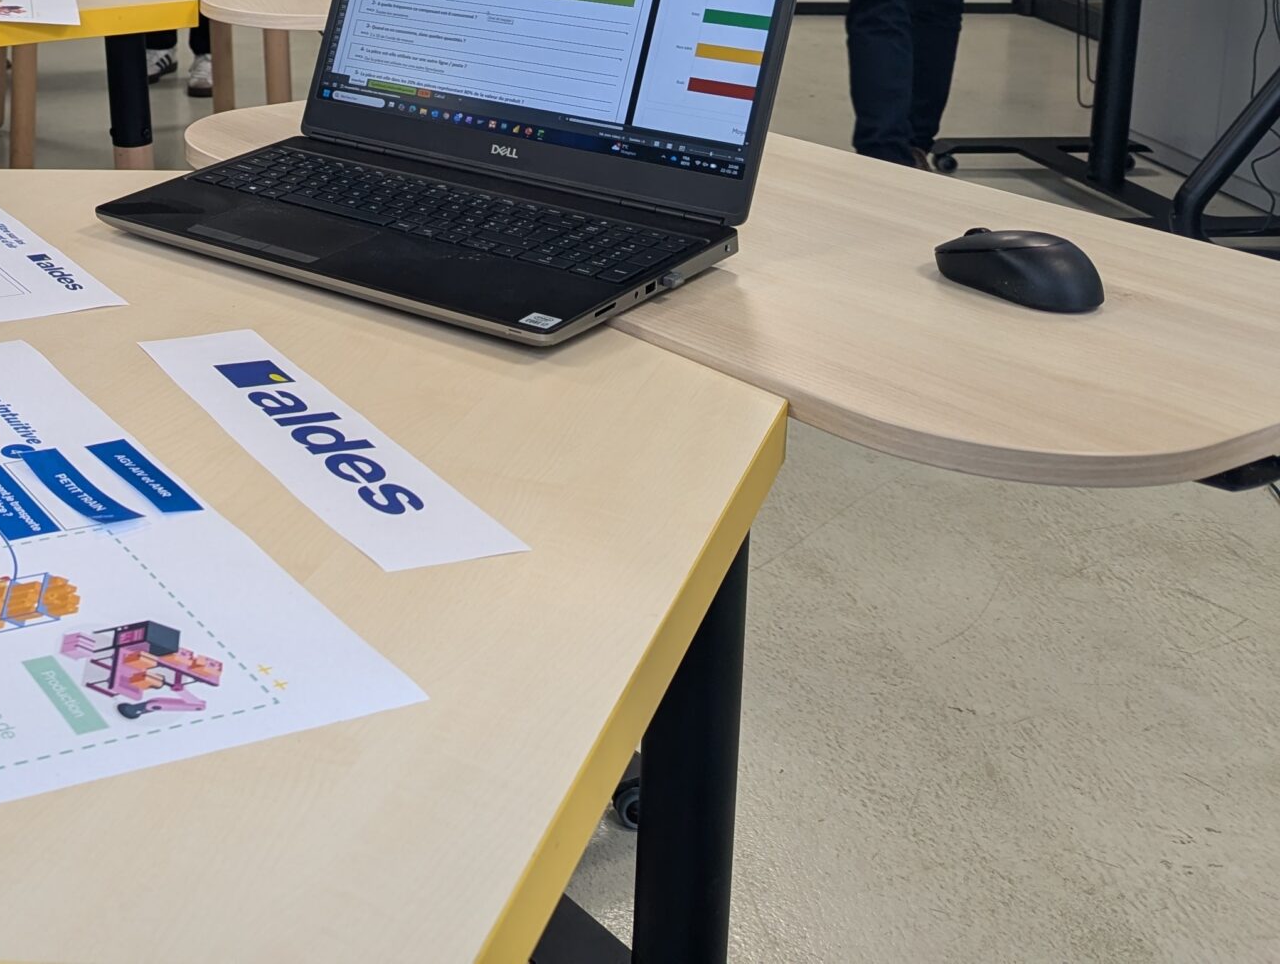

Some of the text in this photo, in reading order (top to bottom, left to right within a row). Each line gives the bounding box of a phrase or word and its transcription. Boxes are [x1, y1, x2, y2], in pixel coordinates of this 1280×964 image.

[491, 144, 518, 158] DELL
[36, 261, 83, 290] aldes
[248, 390, 422, 514] aldes
[55, 473, 106, 511] PETIT TRAIN
[114, 454, 135, 466] AGV
[149, 483, 171, 496] AMR
[9, 500, 40, 531] transporte
[41, 670, 84, 717] Production
